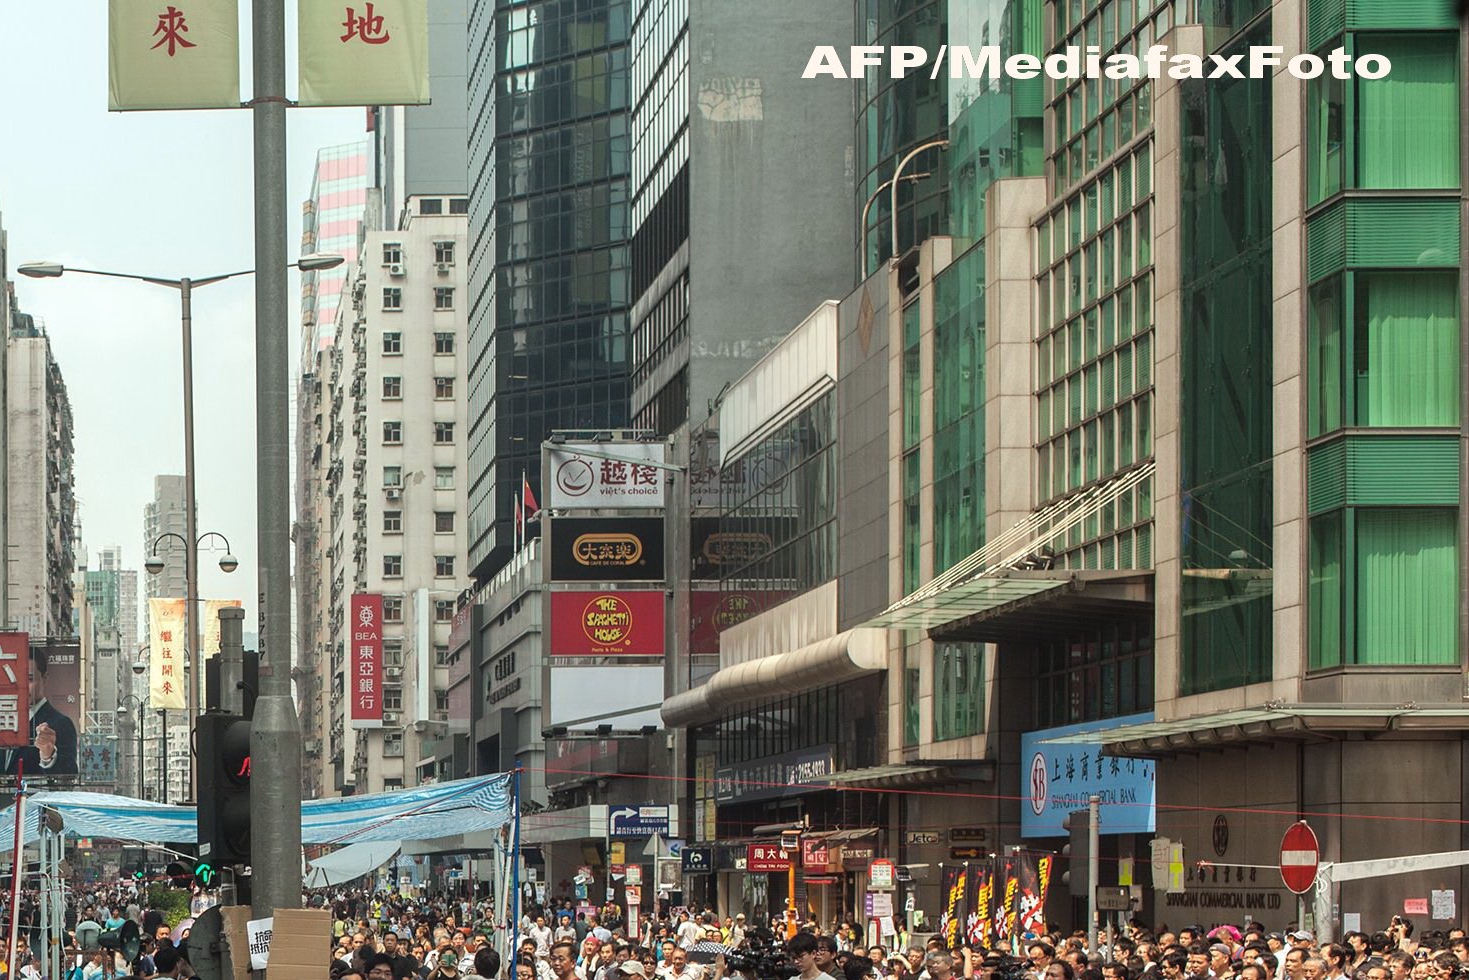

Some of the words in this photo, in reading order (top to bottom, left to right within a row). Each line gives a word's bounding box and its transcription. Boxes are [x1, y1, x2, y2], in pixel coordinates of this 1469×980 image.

[150, 6, 197, 57] 來
[341, 2, 390, 44] 地
[596, 599, 618, 611] THE
[355, 632, 378, 640] BEA
[594, 628, 623, 641] HOUSE
[359, 645, 375, 710] 東亞銀行
[1120, 787, 1137, 805] BANK
